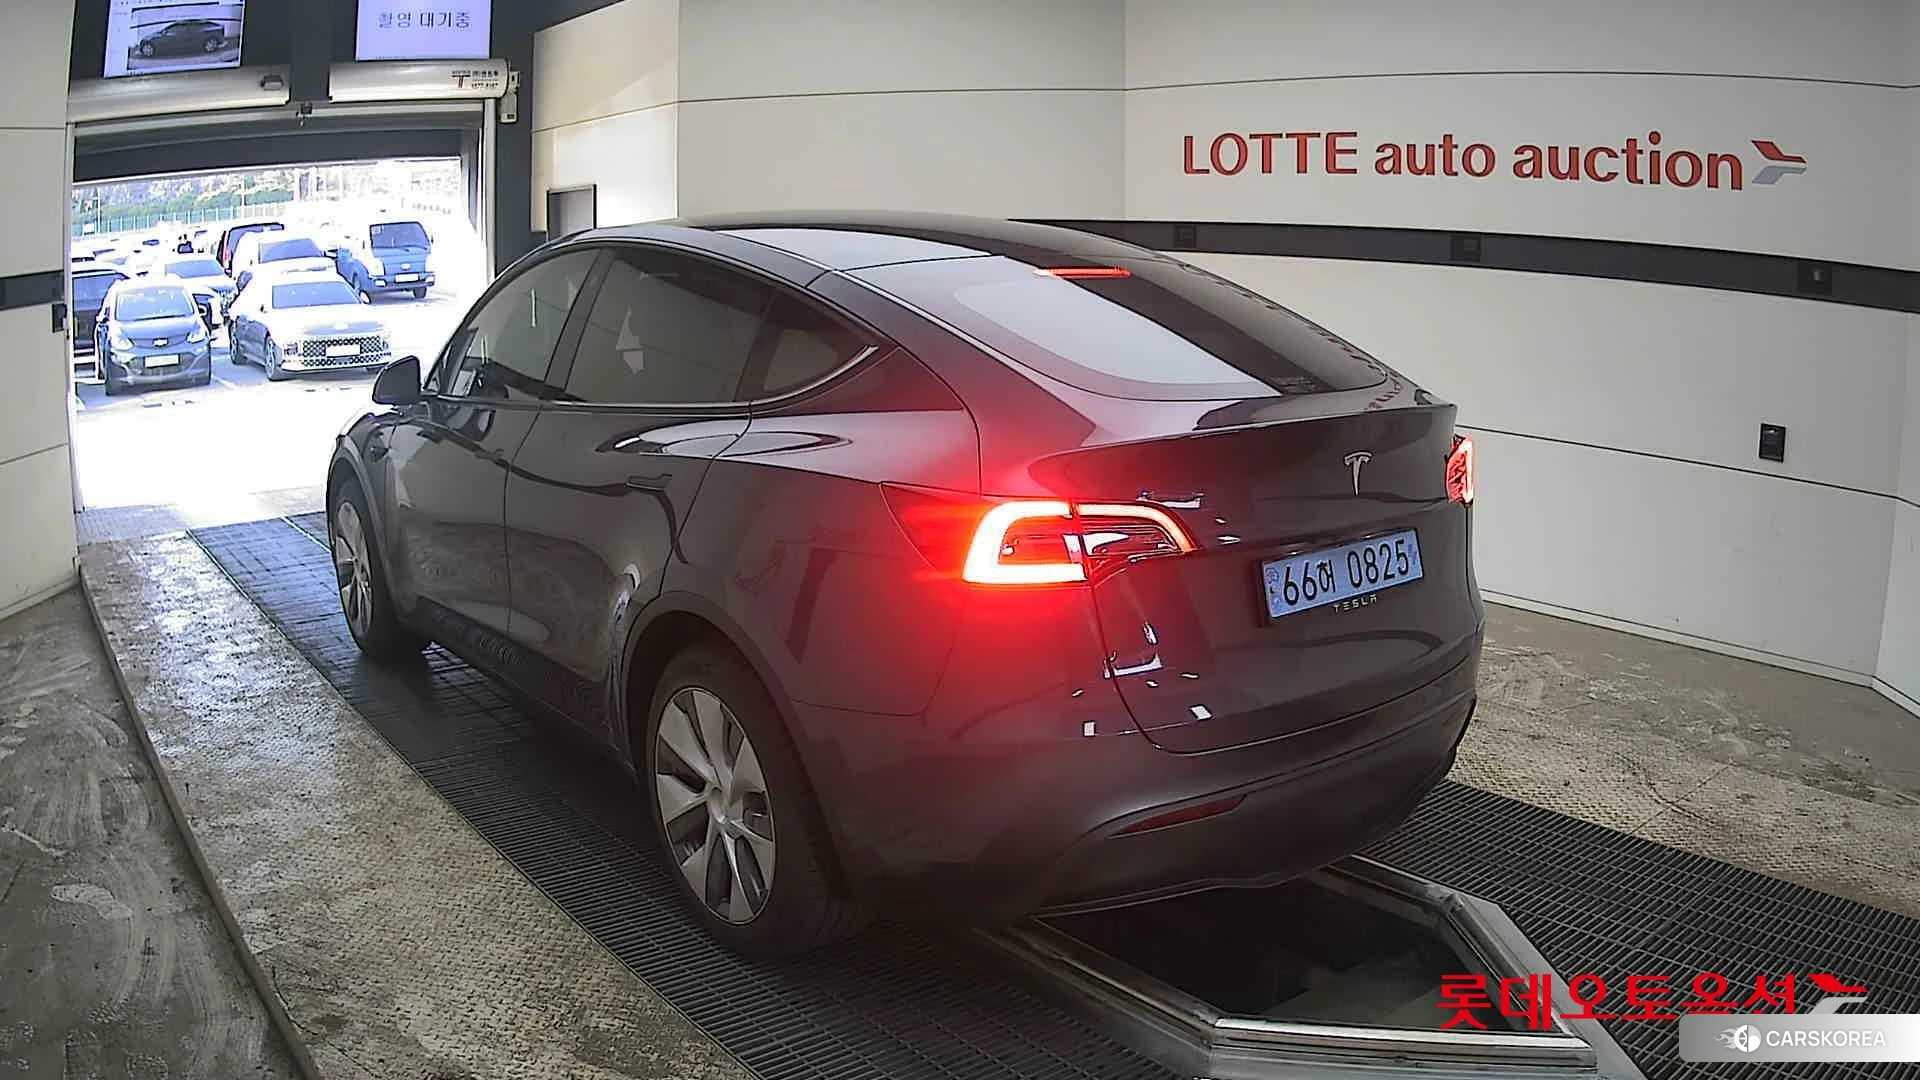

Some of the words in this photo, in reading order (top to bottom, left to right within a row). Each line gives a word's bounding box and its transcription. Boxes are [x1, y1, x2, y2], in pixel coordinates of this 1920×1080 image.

[420, 11, 471, 28] 대기중
[1183, 131, 1359, 175] LOTTE
[1375, 134, 1496, 177] auto
[1512, 131, 1744, 190] auction
[1347, 539, 1409, 588] 0825
[1333, 594, 1377, 613] TESLA
